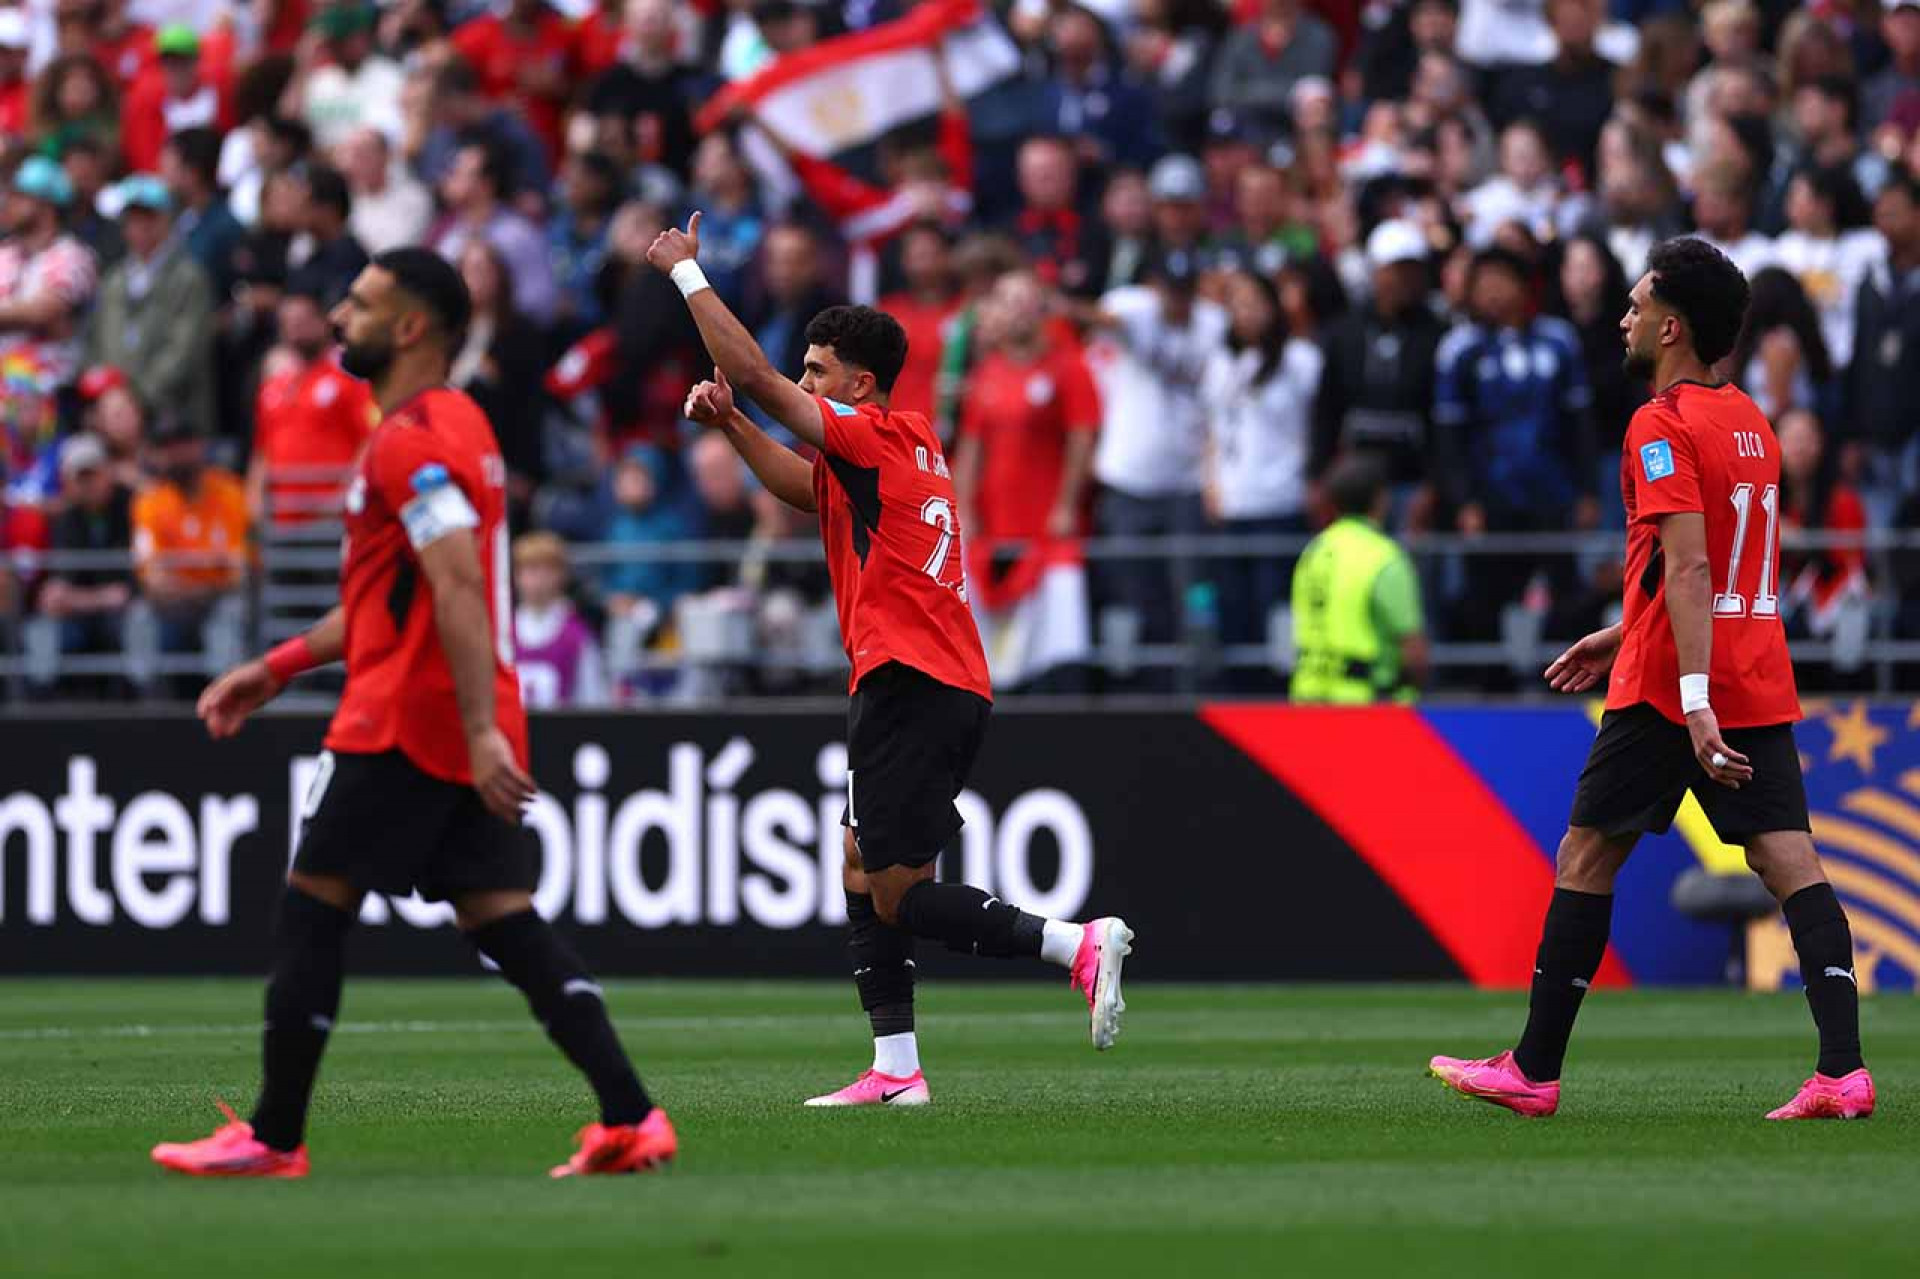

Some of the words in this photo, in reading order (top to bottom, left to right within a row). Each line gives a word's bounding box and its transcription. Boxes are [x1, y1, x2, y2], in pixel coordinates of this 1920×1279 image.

[1733, 431, 1765, 458] ZICO
[1712, 483, 1779, 619] 11
[289, 738, 1093, 969] idísio
